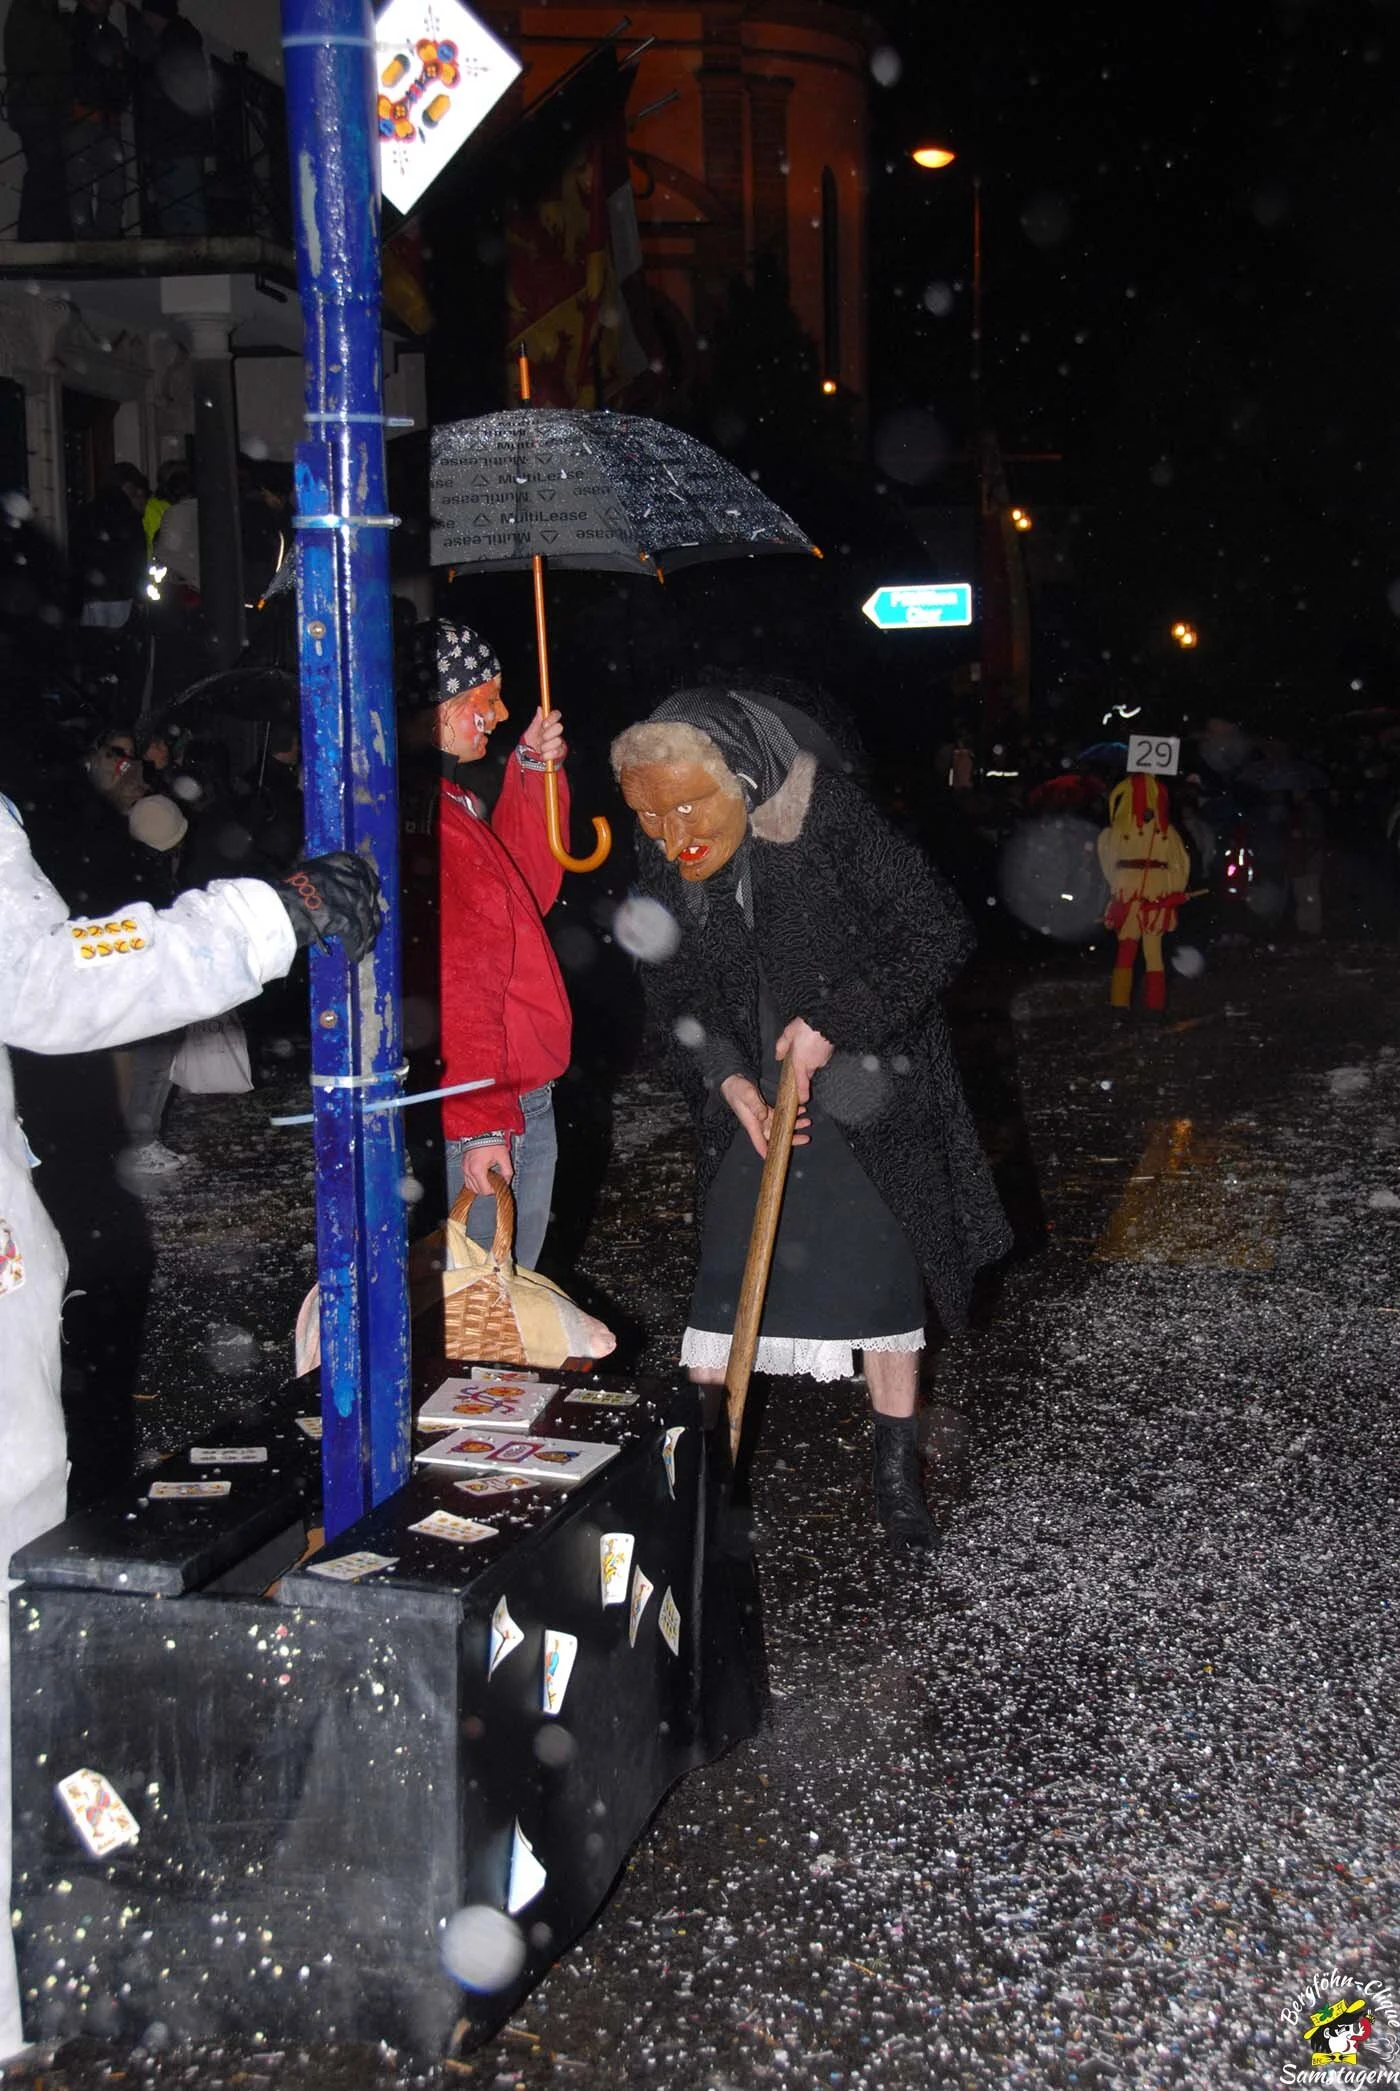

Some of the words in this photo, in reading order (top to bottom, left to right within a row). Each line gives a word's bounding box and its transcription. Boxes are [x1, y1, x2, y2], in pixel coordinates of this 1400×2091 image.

[442, 491, 529, 505] MultiLease
[501, 511, 588, 525] MultiLease
[443, 531, 531, 547] MultiLease
[1136, 740, 1172, 767] 29
